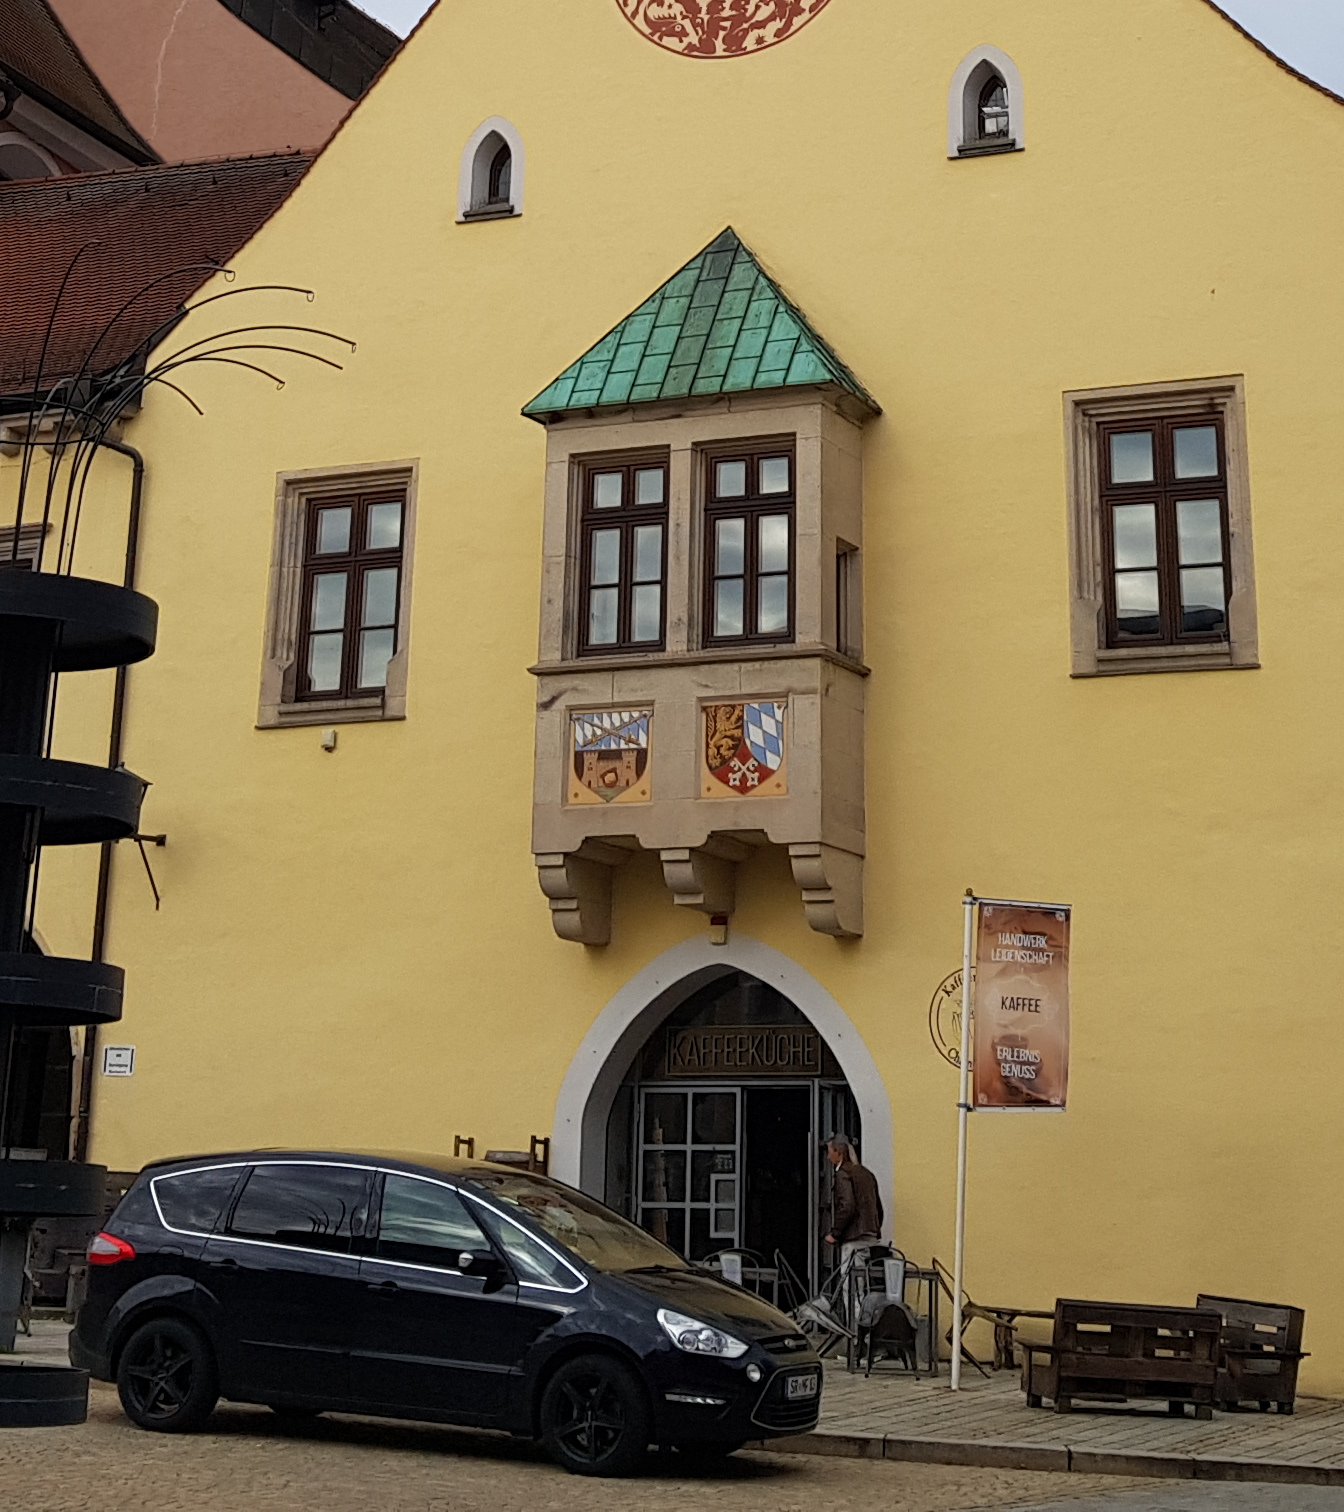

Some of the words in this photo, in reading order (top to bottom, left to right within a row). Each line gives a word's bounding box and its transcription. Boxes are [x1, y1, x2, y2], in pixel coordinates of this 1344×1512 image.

[998, 932, 1047, 948] HANDWERK
[991, 948, 1054, 965] LEIDENSCHAFT
[1001, 996, 1041, 1013] KAFFEE
[671, 1029, 816, 1066] KAFFEEKÜCHE
[996, 1046, 1040, 1063] ERLEBNIS
[1001, 1063, 1036, 1079] GENUSS
